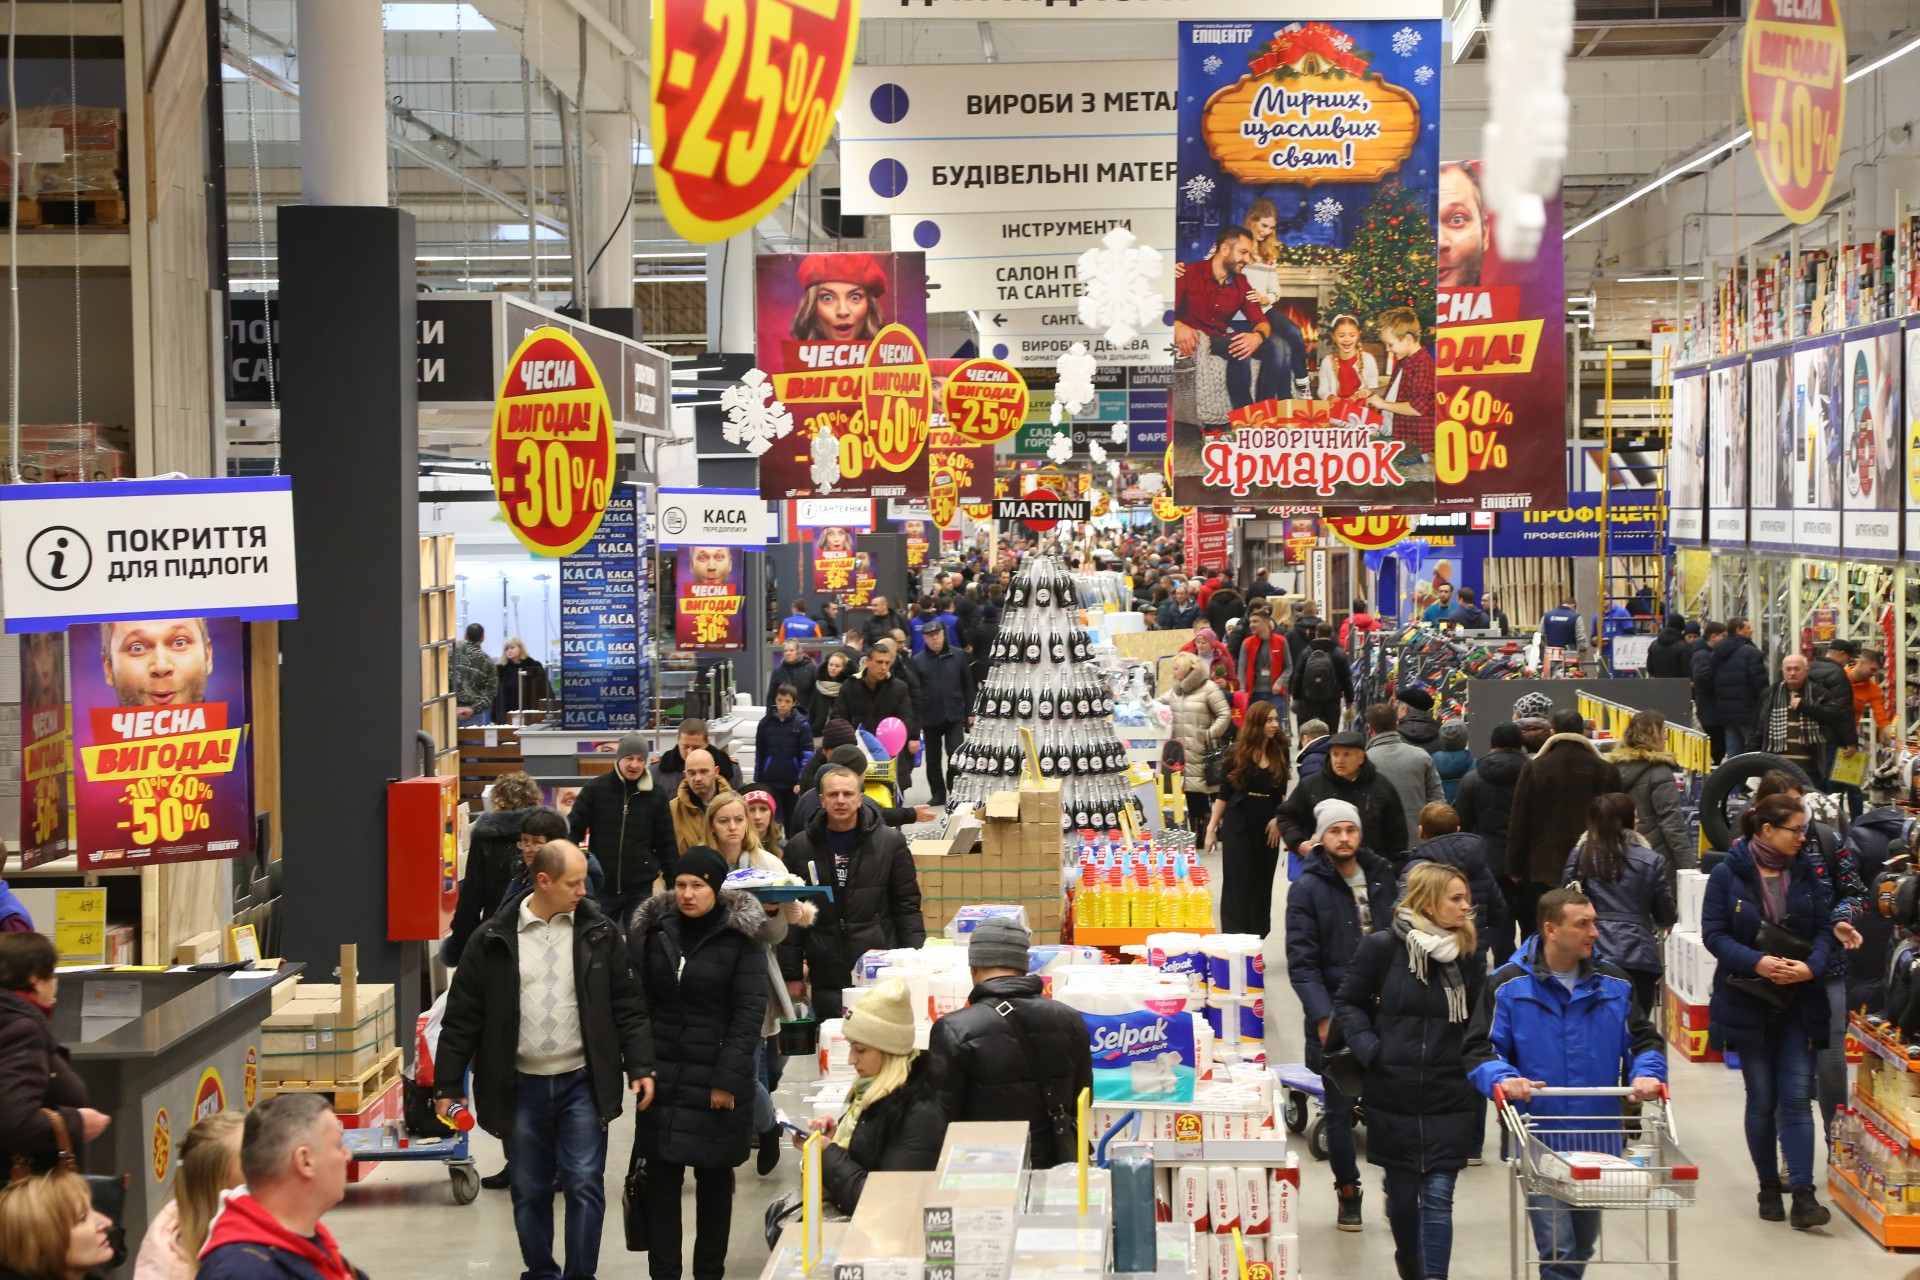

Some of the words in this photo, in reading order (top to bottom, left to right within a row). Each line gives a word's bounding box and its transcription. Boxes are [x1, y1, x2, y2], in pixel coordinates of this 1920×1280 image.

[1192, 29, 1253, 44] ЕПІЦЕНТР
[668, 0, 827, 186] -25%
[967, 92, 1075, 116] ВИРОБИ
[1081, 93, 1097, 114] З
[1253, 85, 1368, 117] Мирних,
[1243, 116, 1377, 145] щасливих
[1756, 77, 1837, 189] -60%
[931, 163, 1089, 189] БУДІВЕЛЬНІ
[1097, 161, 1178, 185] МАТЕР
[996, 265, 1059, 282] САЛОН
[997, 285, 1019, 301] ТА
[1437, 292, 1494, 324] СНА
[1094, 340, 1150, 352] ДЕЕВА
[1436, 334, 1526, 373] ОДА!
[798, 344, 867, 368] ЧЕСН
[879, 344, 914, 364] ЧЕСНА
[520, 360, 577, 391] ЧЕСНА
[966, 369, 1009, 382] ЧЕСНА
[1133, 375, 1173, 384] ШПАЛЕ
[872, 372, 921, 395] ВИГОДА!
[956, 385, 1017, 400] ВИГОДА!
[1449, 385, 1514, 426] 60%
[507, 402, 592, 437] ВИГОДА!
[869, 396, 926, 453] -60%
[951, 399, 1020, 435] -25%
[1238, 427, 1369, 449] НОВОРІЧНИЙ
[1435, 420, 1508, 484] 0%
[502, 438, 606, 528] -30%
[999, 501, 1084, 519] MARTINI
[1481, 496, 1533, 510] ЕПІЦЕНТР
[604, 513, 633, 522] КАСА
[703, 509, 747, 524] КАСА
[107, 525, 267, 554] ПОКРИТТЯ
[1523, 529, 1603, 541] ПРОФЕСІЙНИ
[598, 543, 634, 553] КАСА
[108, 558, 158, 583] ДЛЯ
[164, 555, 269, 581] ПІДЛОГИ
[563, 568, 604, 580] КАСА
[607, 571, 634, 579] КАСА
[605, 585, 634, 593] КАСА
[691, 585, 728, 597] ЧЕСНА
[563, 606, 590, 615] КАСА
[685, 600, 737, 612] ВИГОДА!
[599, 614, 635, 624] КАСА
[691, 622, 728, 643] -50%
[564, 641, 606, 652] КАСА
[608, 643, 635, 651] КАСА
[606, 657, 635, 665] КАСА
[564, 678, 591, 687] КАСА
[600, 686, 636, 697] КАСА
[111, 708, 206, 739] ЧЕСНА
[565, 711, 606, 723] КАСА
[609, 713, 636, 722] КАСА
[96, 739, 232, 775] ВИГОДА!
[169, 773, 214, 801] 60%
[116, 798, 210, 846] -50%
[1161, 958, 1193, 973] Selpak
[1089, 1017, 1169, 1054] Selpak
[1127, 1047, 1151, 1057] Super
[1150, 1042, 1168, 1052] Soft
[1177, 1117, 1196, 1131] -25
[928, 1211, 951, 1224] M2
[930, 1240, 953, 1254] M2
[839, 1267, 863, 1280] M2
[930, 1269, 952, 1280] M2
[1248, 1267, 1266, 1280] -25
